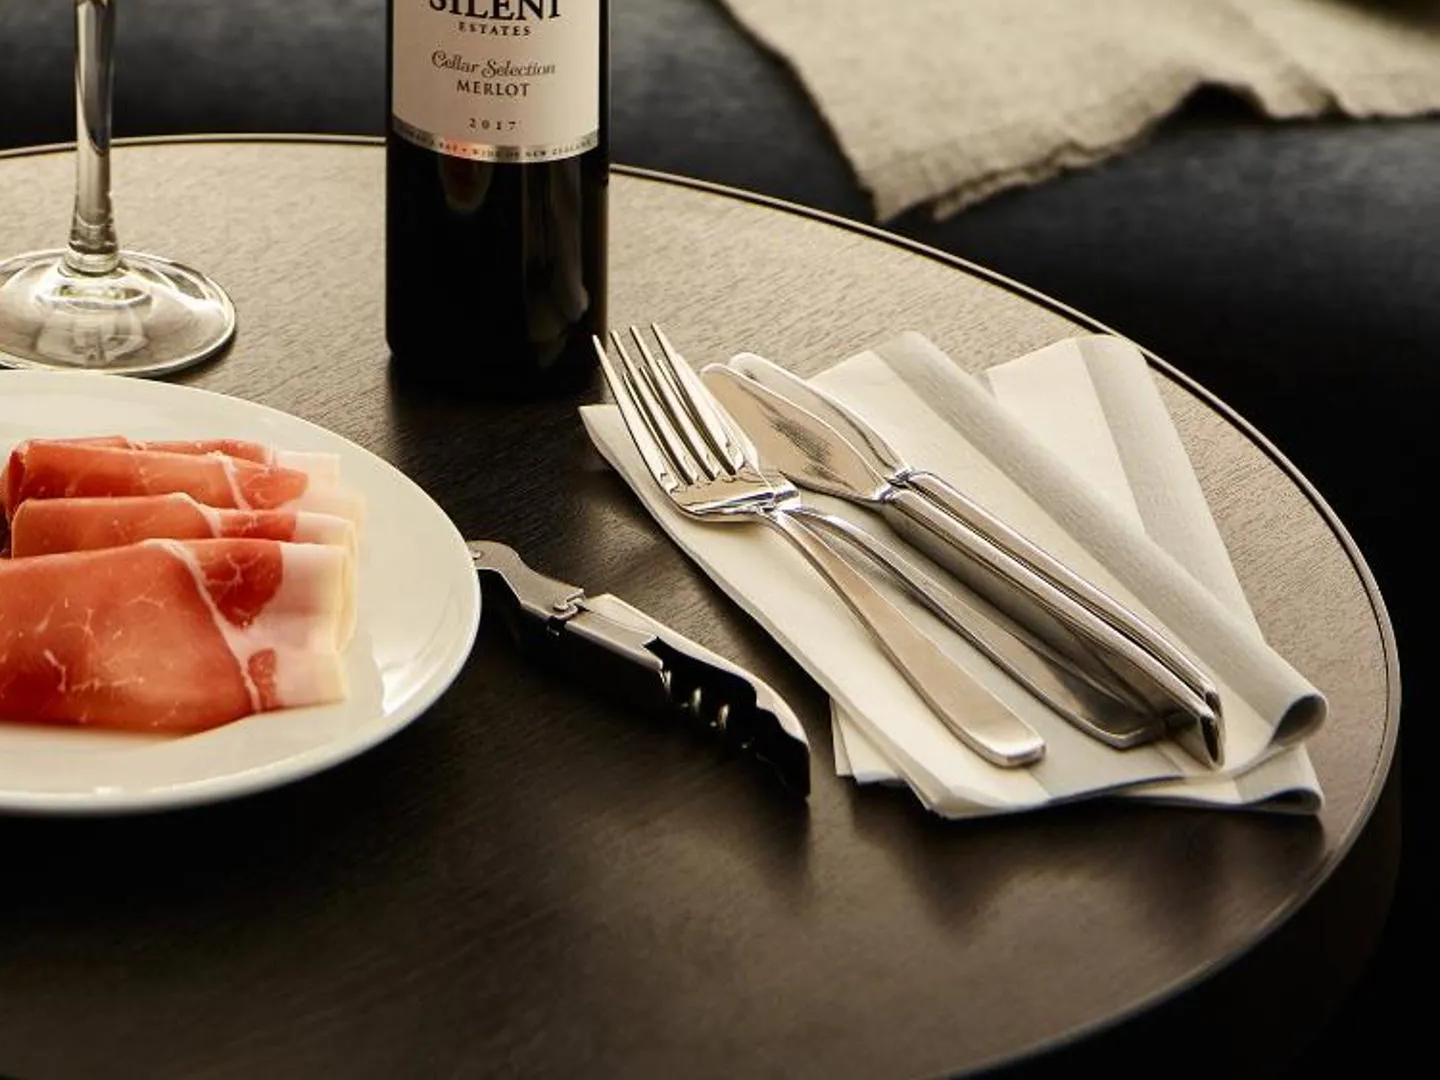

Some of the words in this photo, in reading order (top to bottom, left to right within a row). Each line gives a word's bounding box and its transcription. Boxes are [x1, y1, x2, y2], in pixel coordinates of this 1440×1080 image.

[459, 22, 532, 36] ESTATES
[431, 50, 479, 74] Cellar
[480, 59, 556, 78] Selection
[456, 80, 530, 97] MERLOT
[469, 118, 517, 131] 2017
